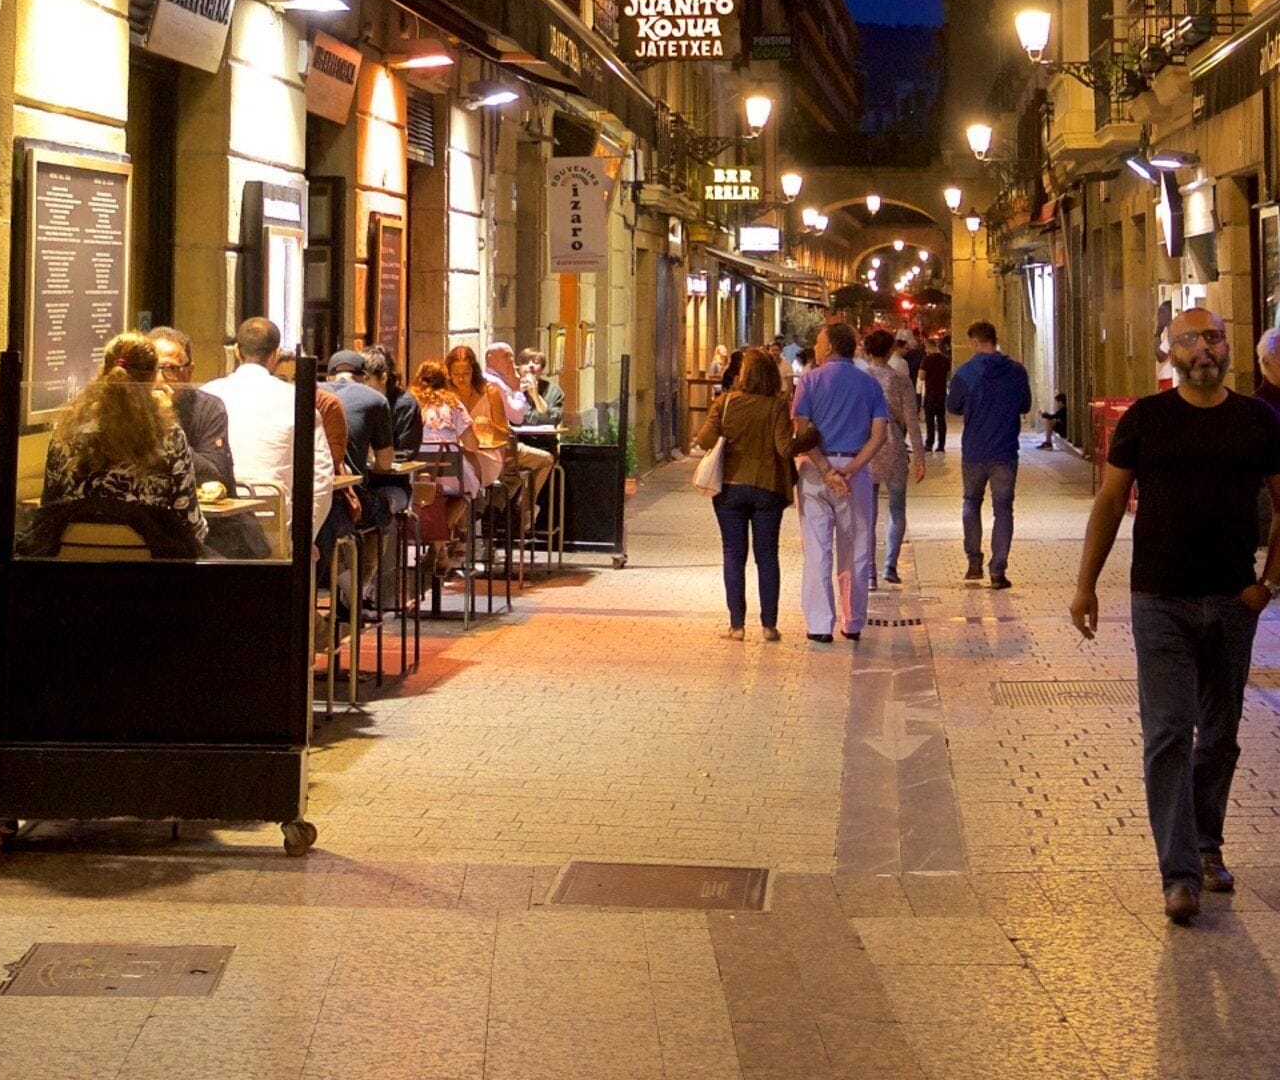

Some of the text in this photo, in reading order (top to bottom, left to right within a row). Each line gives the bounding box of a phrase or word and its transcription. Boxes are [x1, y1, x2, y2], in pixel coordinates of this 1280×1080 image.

[637, 16, 722, 41] KOJUA
[635, 40, 724, 58] JATETXEA
[753, 35, 791, 46] PENSION
[713, 168, 752, 183] BAR
[570, 184, 583, 251] izaro
